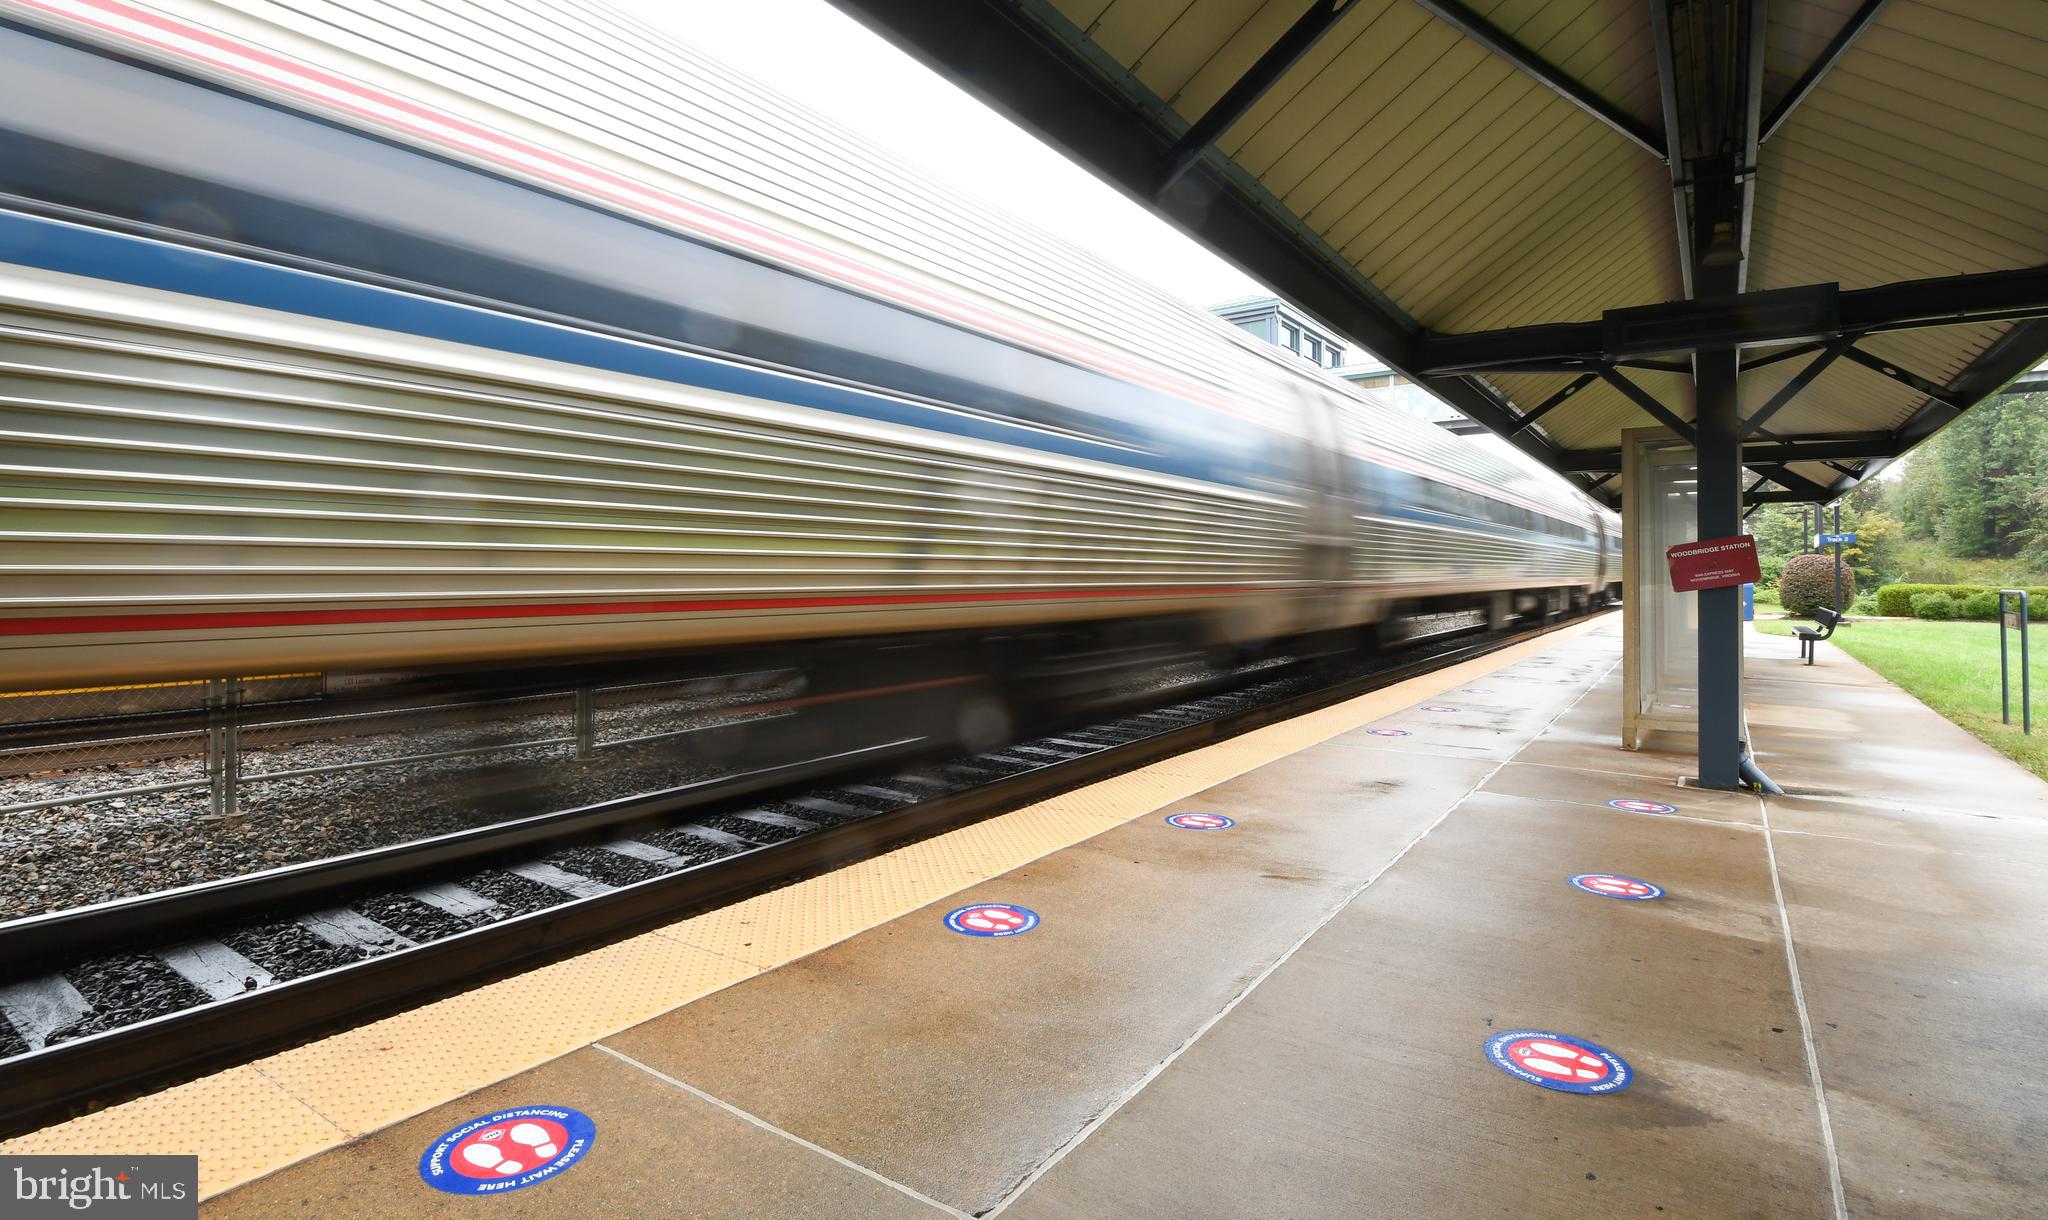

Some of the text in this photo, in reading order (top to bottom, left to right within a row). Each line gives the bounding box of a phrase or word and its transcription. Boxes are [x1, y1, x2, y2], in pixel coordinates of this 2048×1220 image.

[1670, 541, 1751, 558] WOODBRIDGE STATION
[1498, 1032, 1557, 1043] DISTANCING
[1500, 1059, 1543, 1083] SUPPORT
[430, 1109, 569, 1176] SUPPORT SOCIAL DISTANCING
[477, 1138, 585, 1191] PLEASE WAIT HERE
